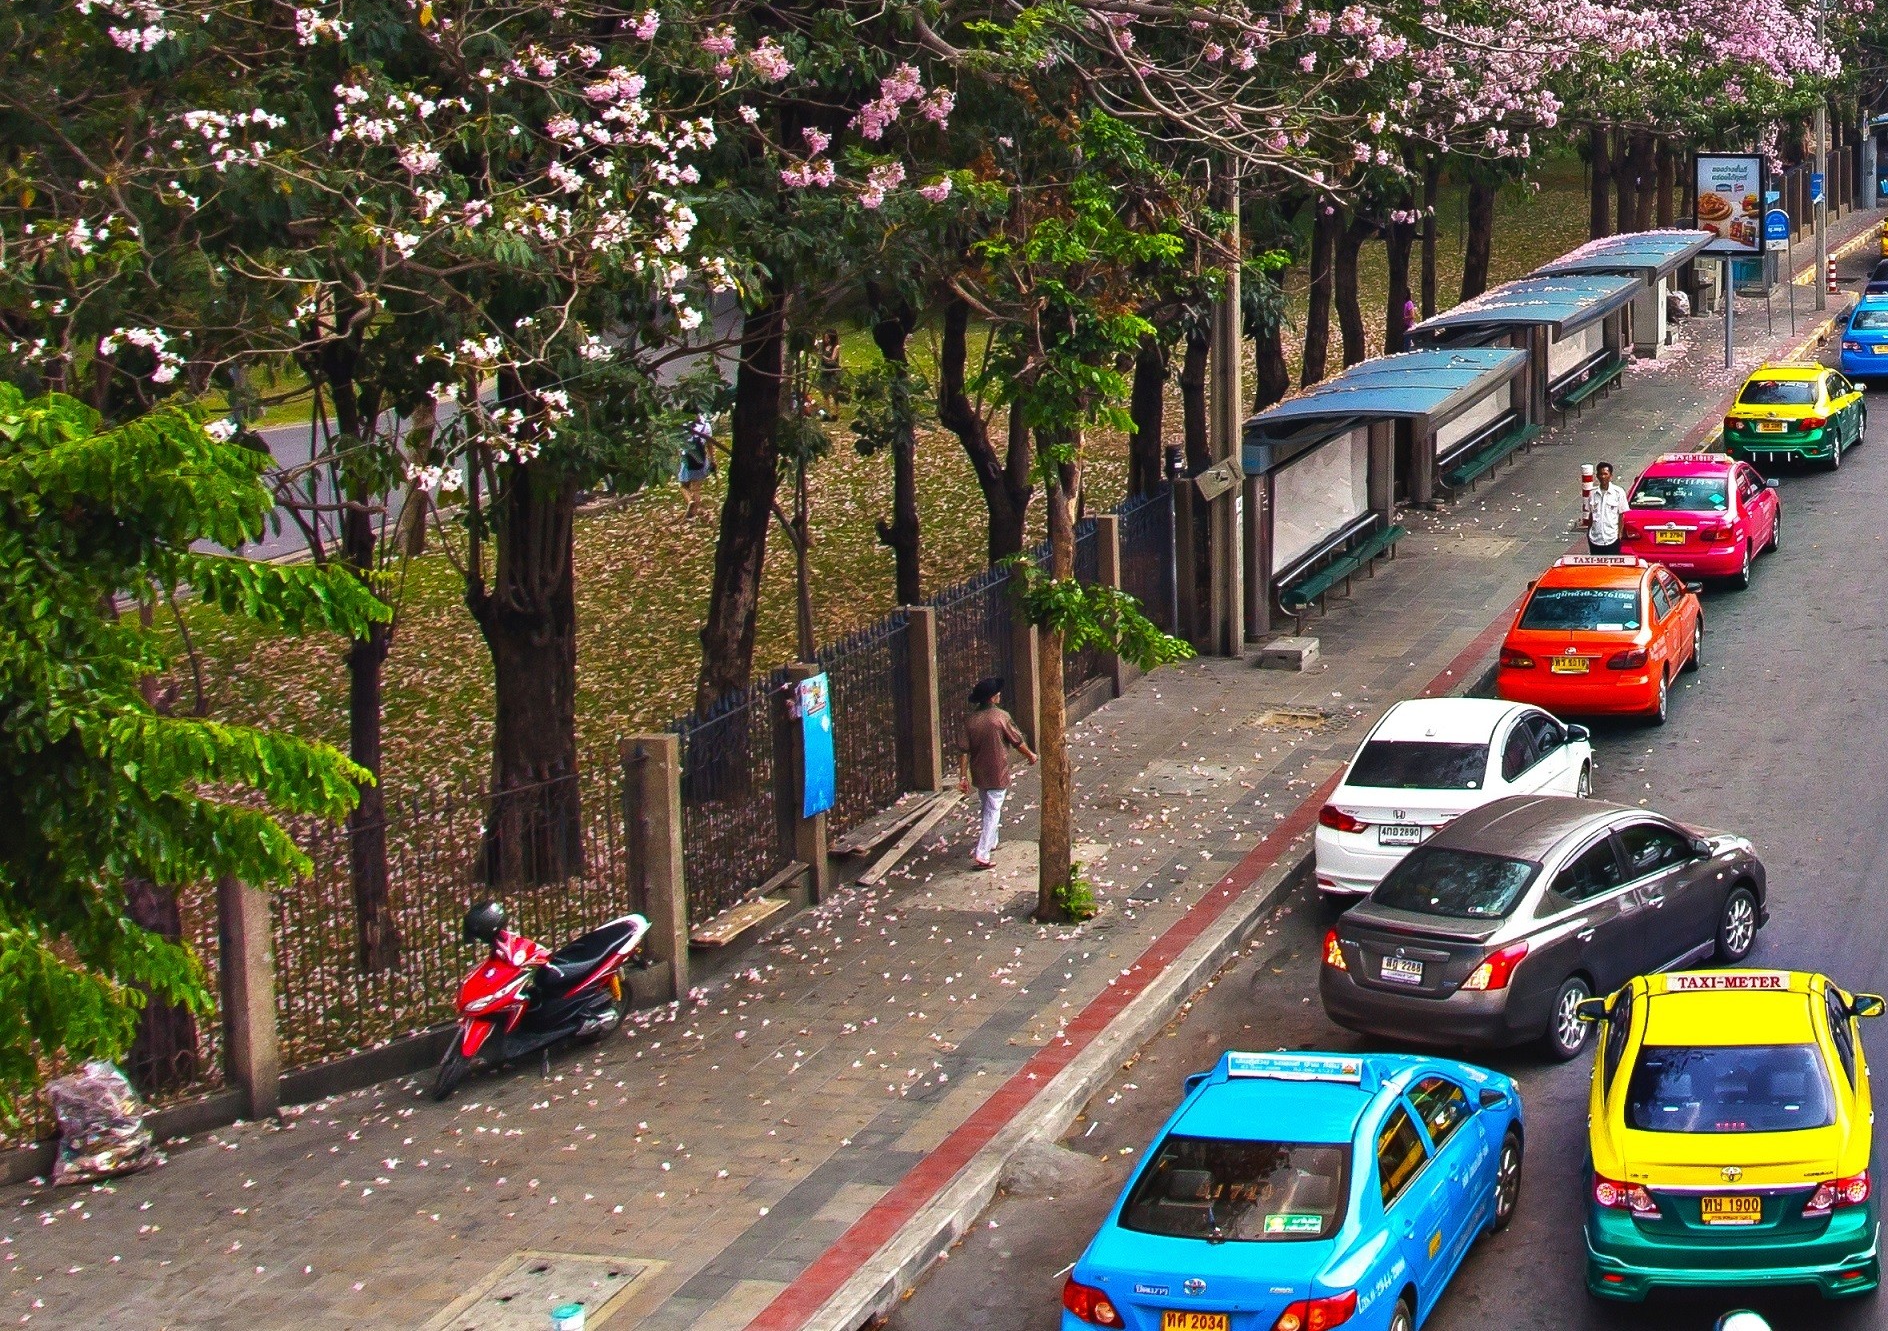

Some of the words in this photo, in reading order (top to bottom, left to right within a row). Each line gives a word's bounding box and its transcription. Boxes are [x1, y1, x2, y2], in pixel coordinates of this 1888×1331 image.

[1678, 976, 1782, 989] TAXI-METER
[1729, 1198, 1759, 1212] 1900
[1191, 1314, 1224, 1330] 2034
